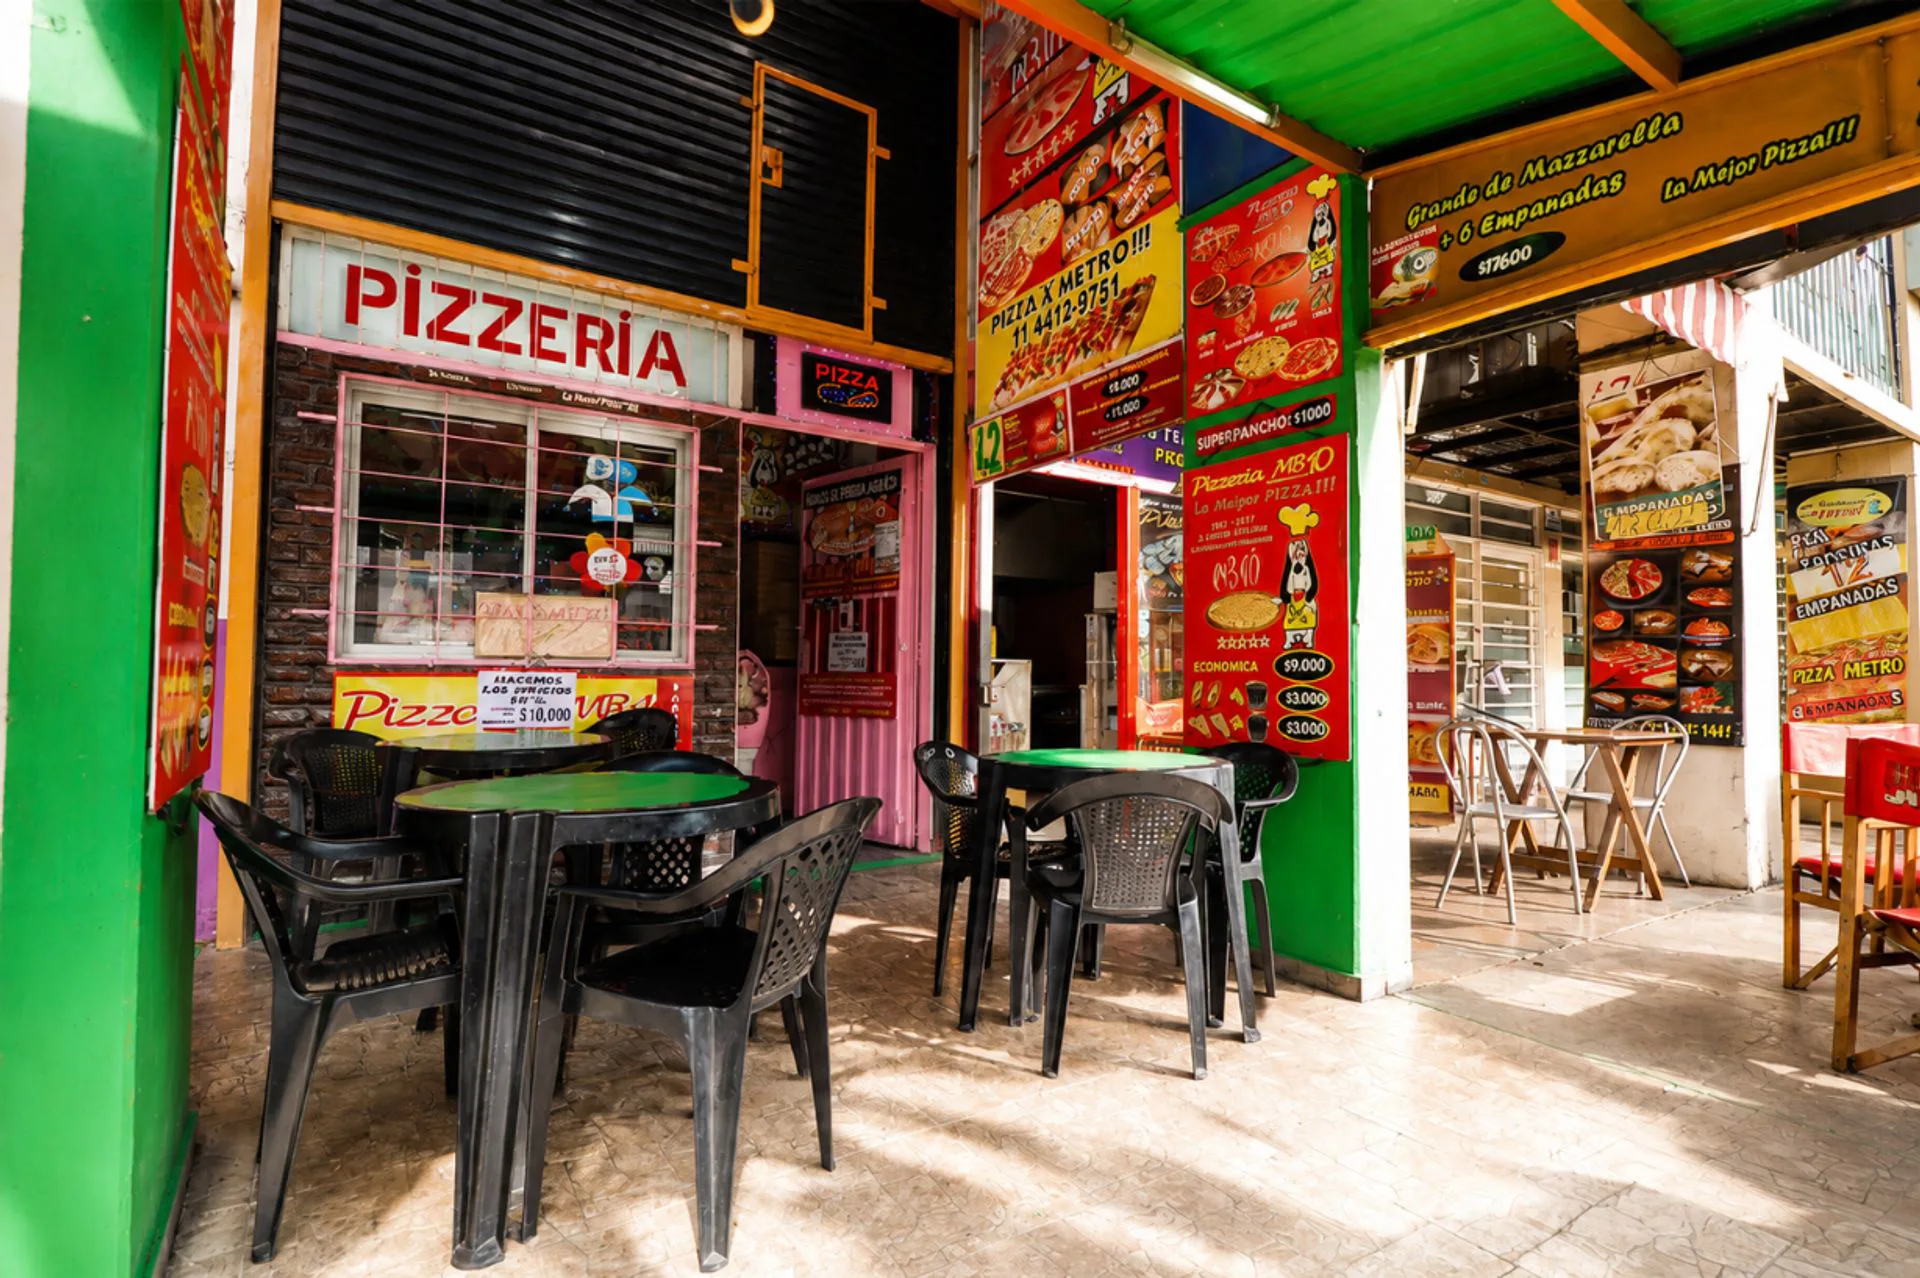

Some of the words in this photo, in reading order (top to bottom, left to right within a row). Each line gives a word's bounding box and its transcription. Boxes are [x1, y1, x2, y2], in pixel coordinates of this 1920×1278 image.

[1408, 189, 1477, 229] Grande
[1485, 174, 1512, 196] de
[1519, 114, 1681, 185] Mazzarella
[1663, 179, 1686, 200] La
[1693, 154, 1756, 188] Mejor
[1764, 118, 1858, 167] Pizza!!!
[1460, 223, 1472, 243] 6
[1481, 172, 1624, 235] Empanadas
[1478, 245, 1532, 277] $17600
[991, 299, 1037, 336] PIZZA
[1013, 320, 1029, 348] 11
[1033, 271, 1119, 337] 4412-9751
[816, 363, 879, 391] PIZZA
[1294, 402, 1332, 424] $1000
[1191, 468, 1266, 497] Pizzeria
[1796, 577, 1899, 619] EMPANADAS
[1193, 661, 1259, 673] ECONOMICA
[1284, 658, 1327, 672] $9.000
[1793, 664, 1835, 685] PIZZA
[1844, 657, 1905, 680] METRO
[1285, 691, 1328, 705] $3.000
